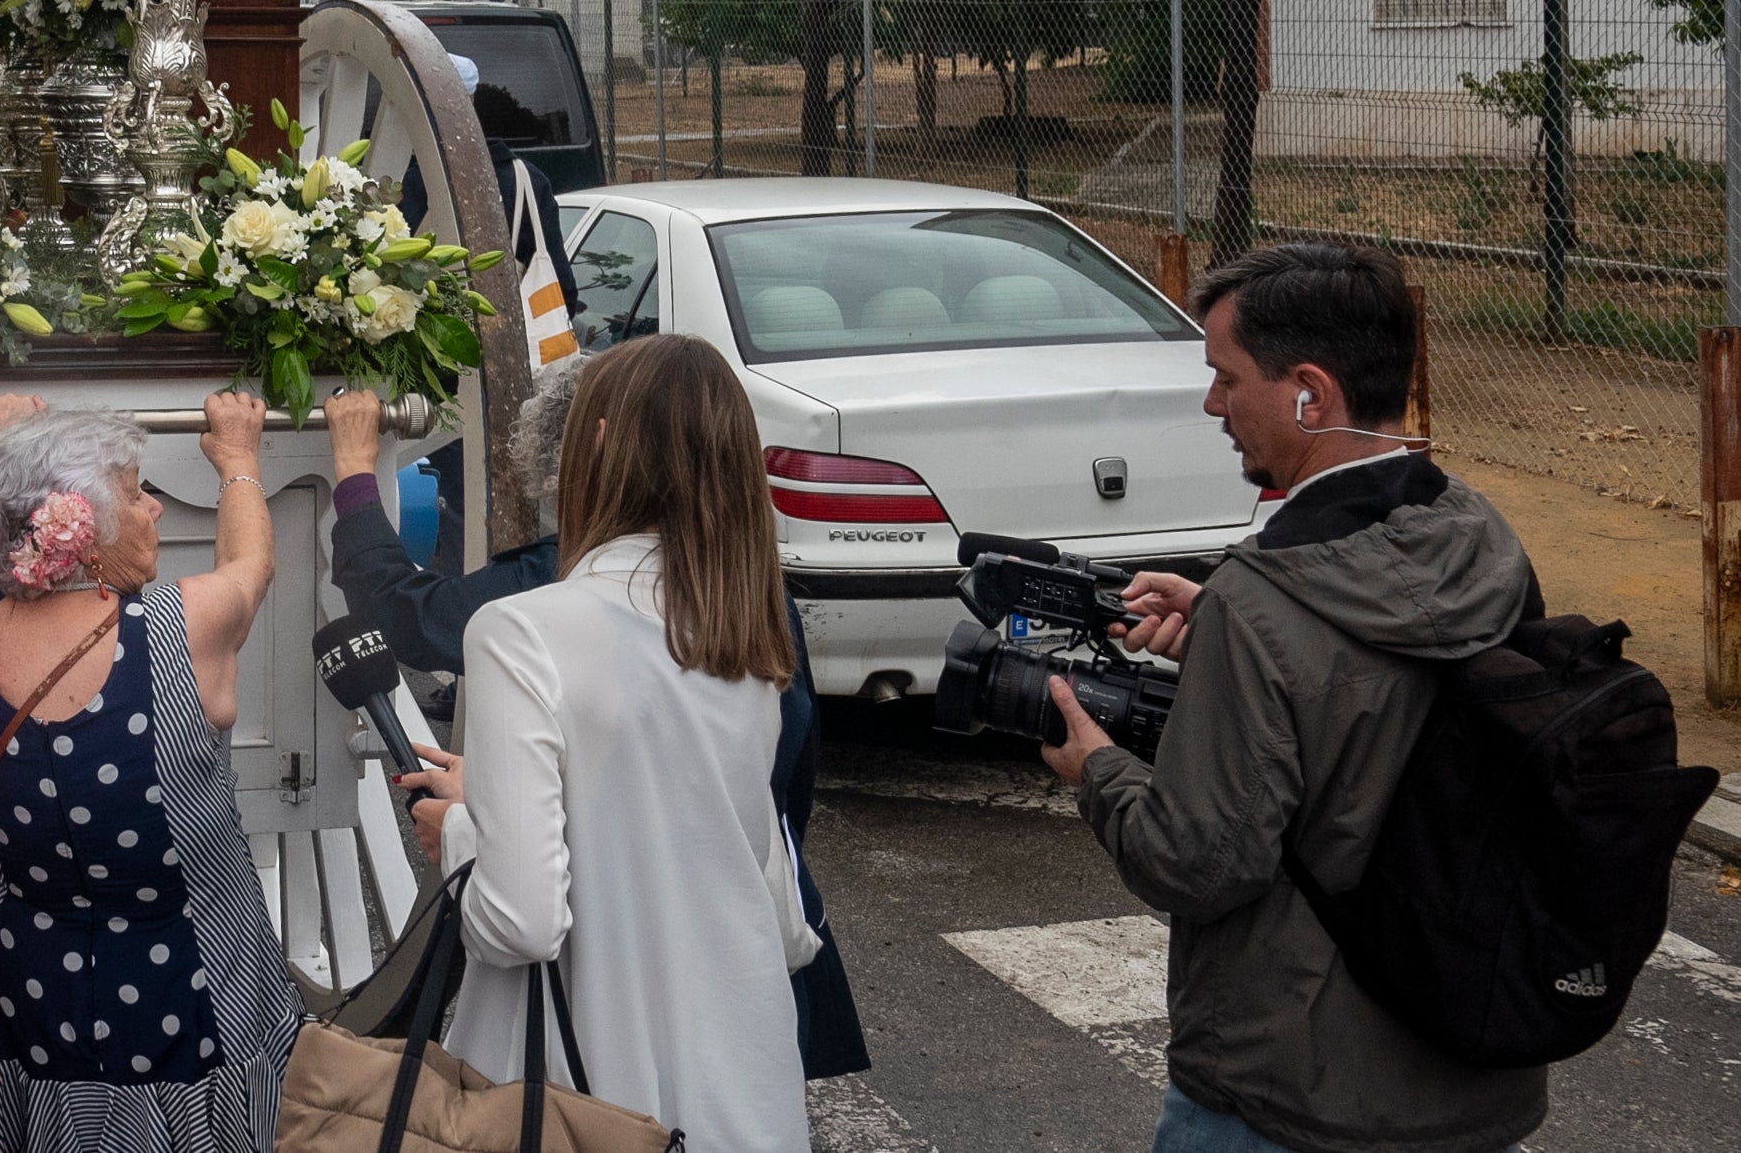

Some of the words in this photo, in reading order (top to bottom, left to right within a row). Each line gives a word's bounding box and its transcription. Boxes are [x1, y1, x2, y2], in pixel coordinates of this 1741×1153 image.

[828, 528, 927, 543] PEUGEOT
[355, 644, 388, 659] TELECOM
[1555, 979, 1607, 996] adidas
